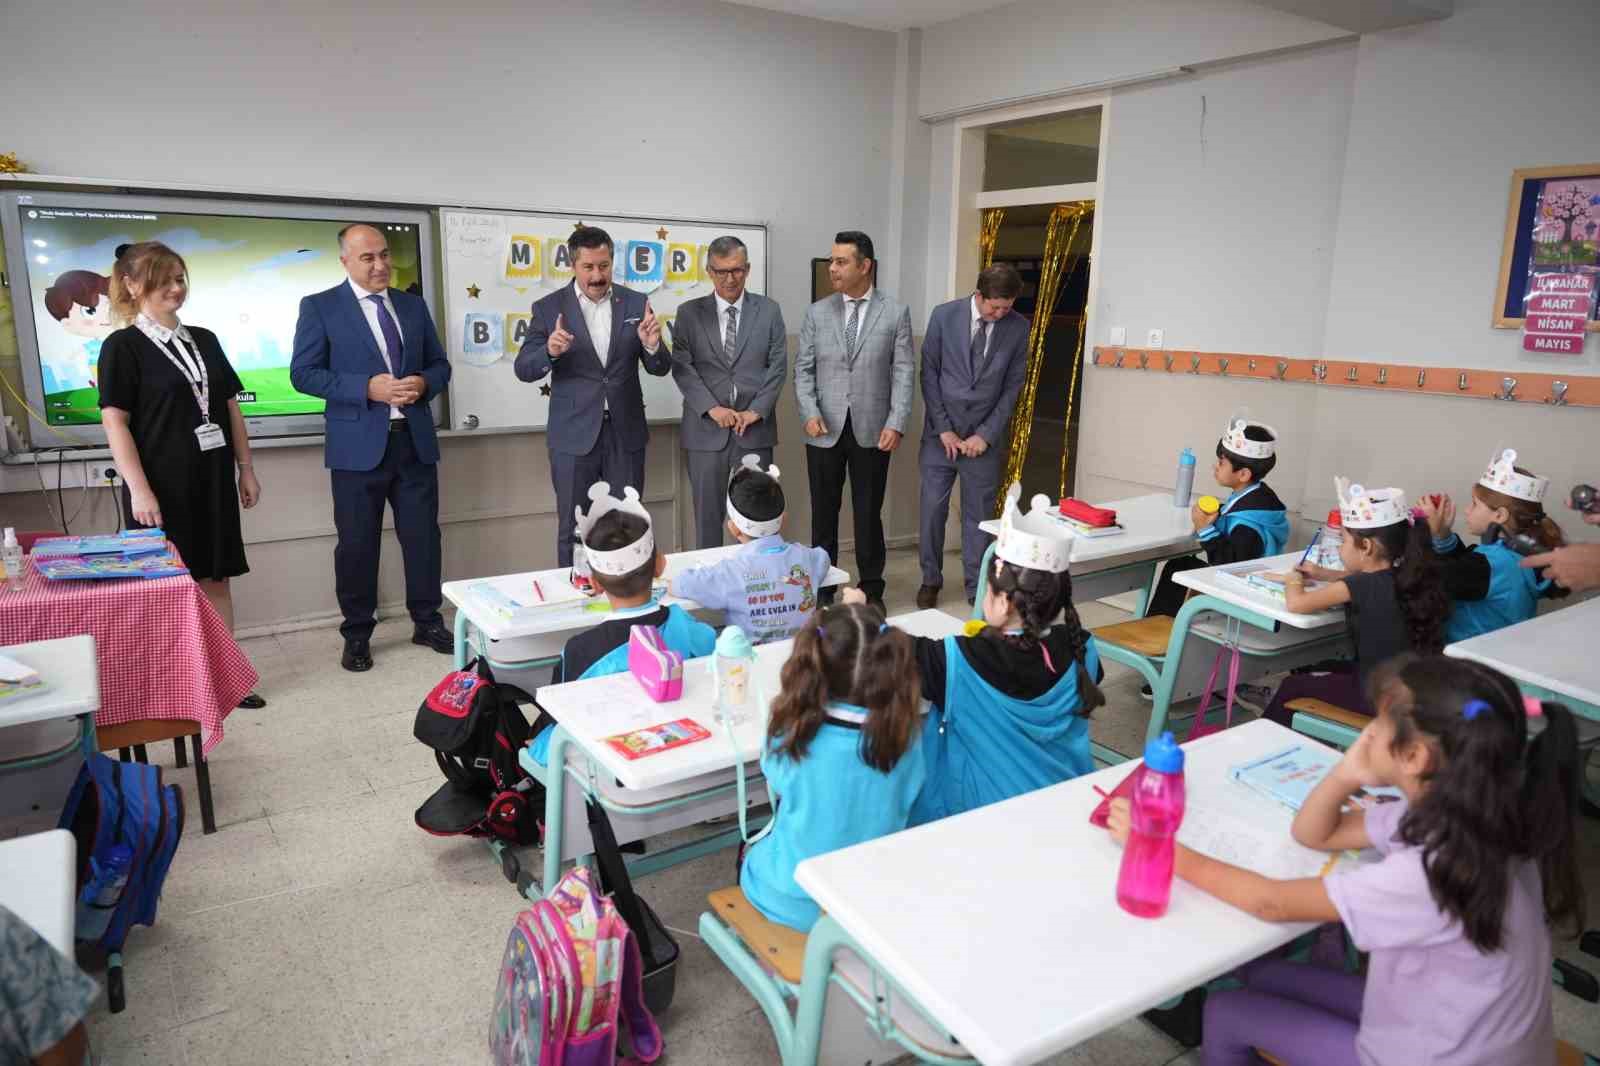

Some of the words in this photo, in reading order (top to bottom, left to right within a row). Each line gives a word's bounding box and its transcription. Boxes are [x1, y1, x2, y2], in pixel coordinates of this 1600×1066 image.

[1542, 299, 1575, 309] MART
[1538, 317, 1574, 329] NİSAN
[1535, 339, 1571, 350] MAYIS
[750, 608, 767, 616] ARE
[768, 606, 787, 615] EVER
